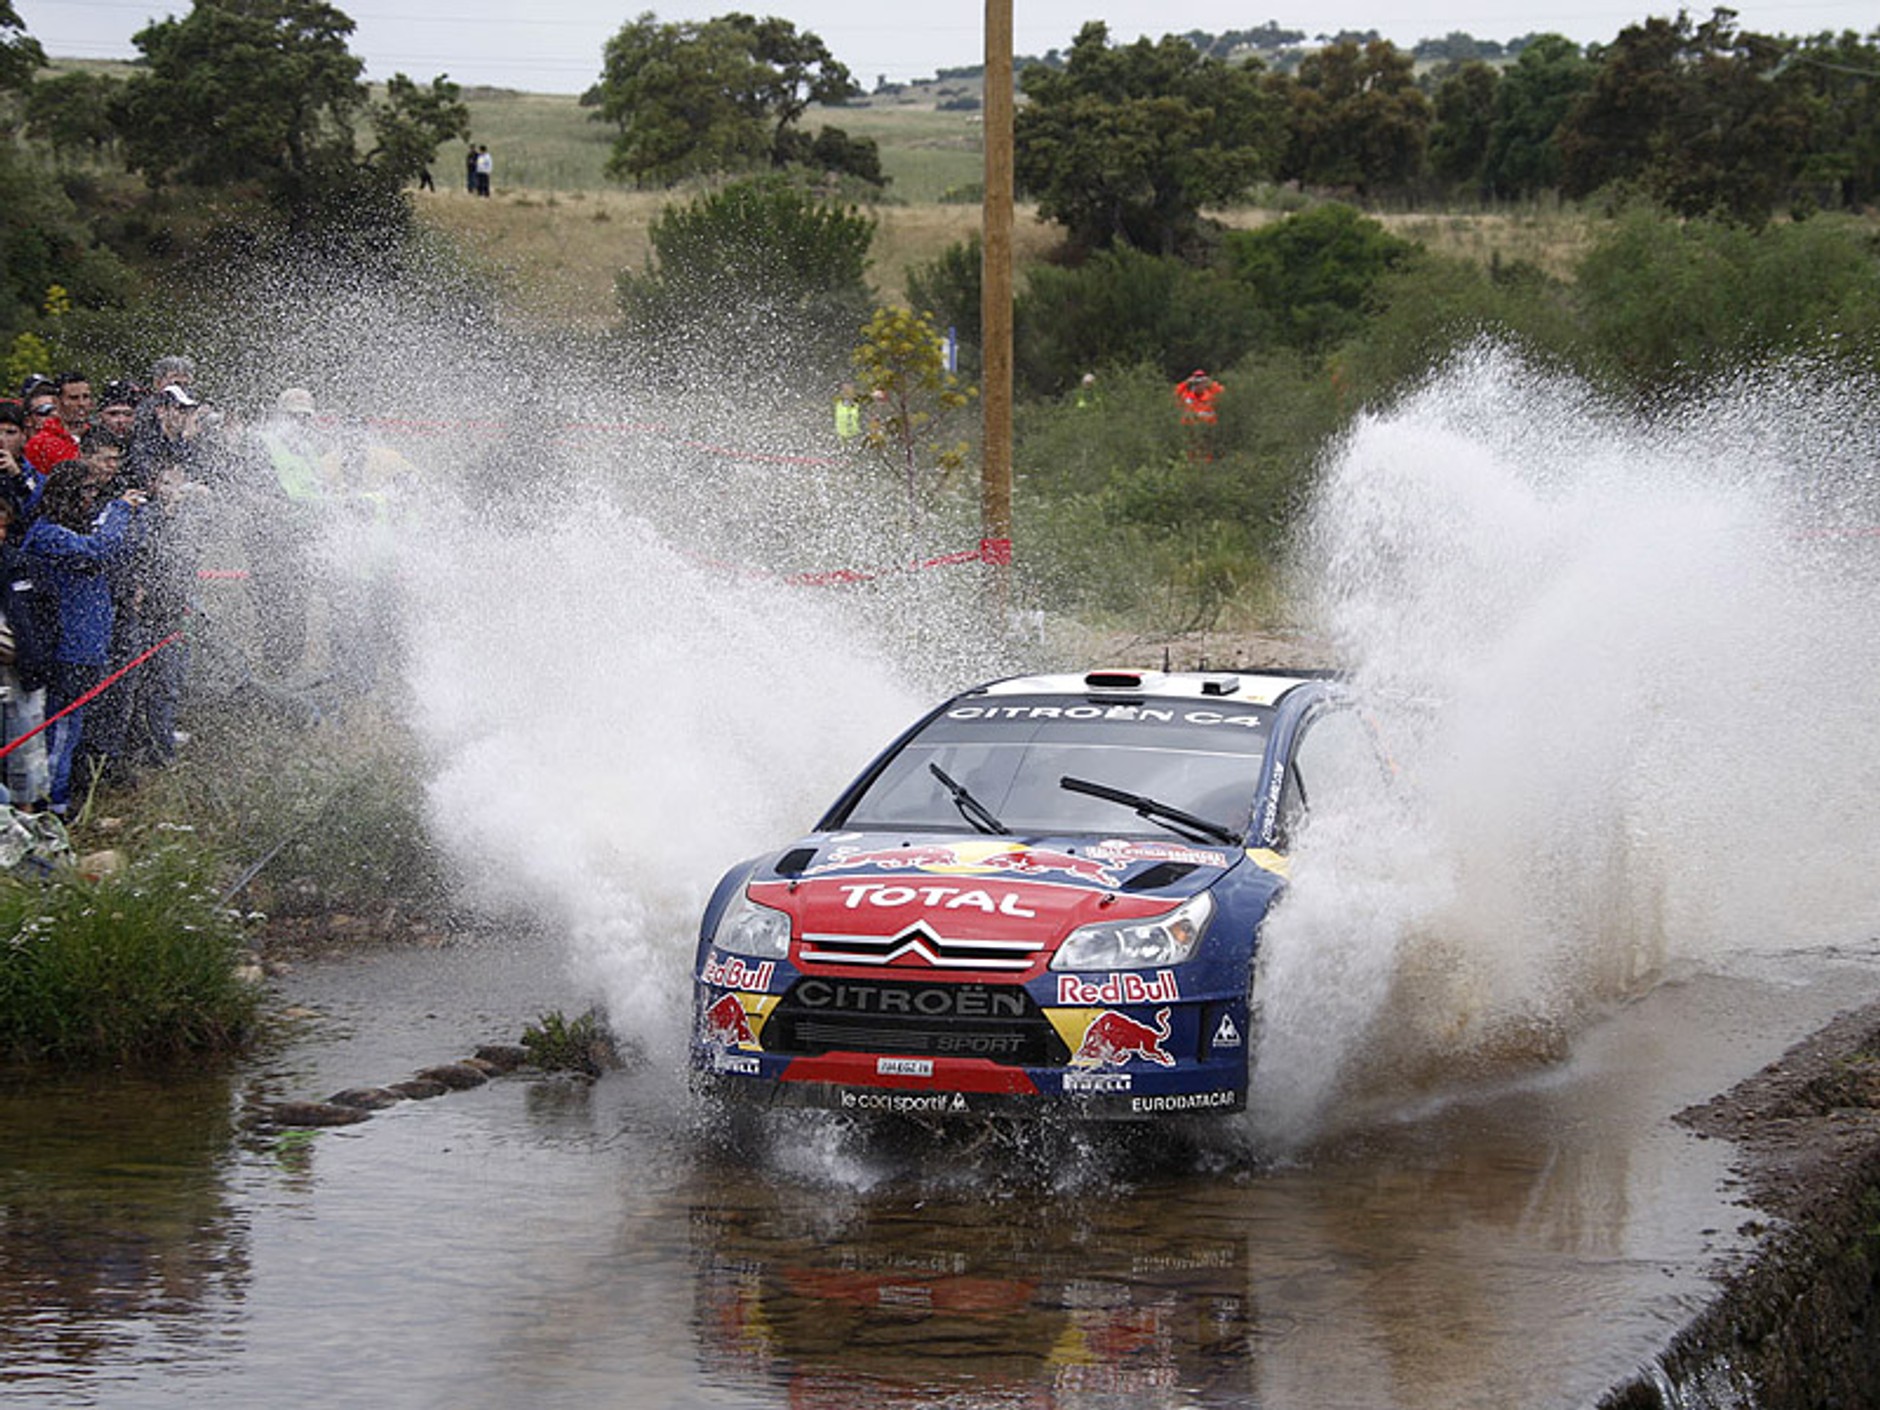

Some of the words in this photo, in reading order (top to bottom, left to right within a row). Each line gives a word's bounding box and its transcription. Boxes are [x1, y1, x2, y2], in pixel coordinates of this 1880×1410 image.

[1184, 711, 1261, 727] C4
[839, 883, 1036, 918] TOTAL
[727, 960, 776, 991] Bull
[1058, 973, 1120, 1005] Red
[1122, 969, 1180, 1002] Bull
[796, 980, 1024, 1016] CITROËN
[937, 1034, 1027, 1053] SPORT
[841, 1090, 857, 1108] le
[858, 1094, 892, 1111] coq
[893, 1094, 949, 1114] sportif
[1132, 1091, 1236, 1112] EURODATACAR
